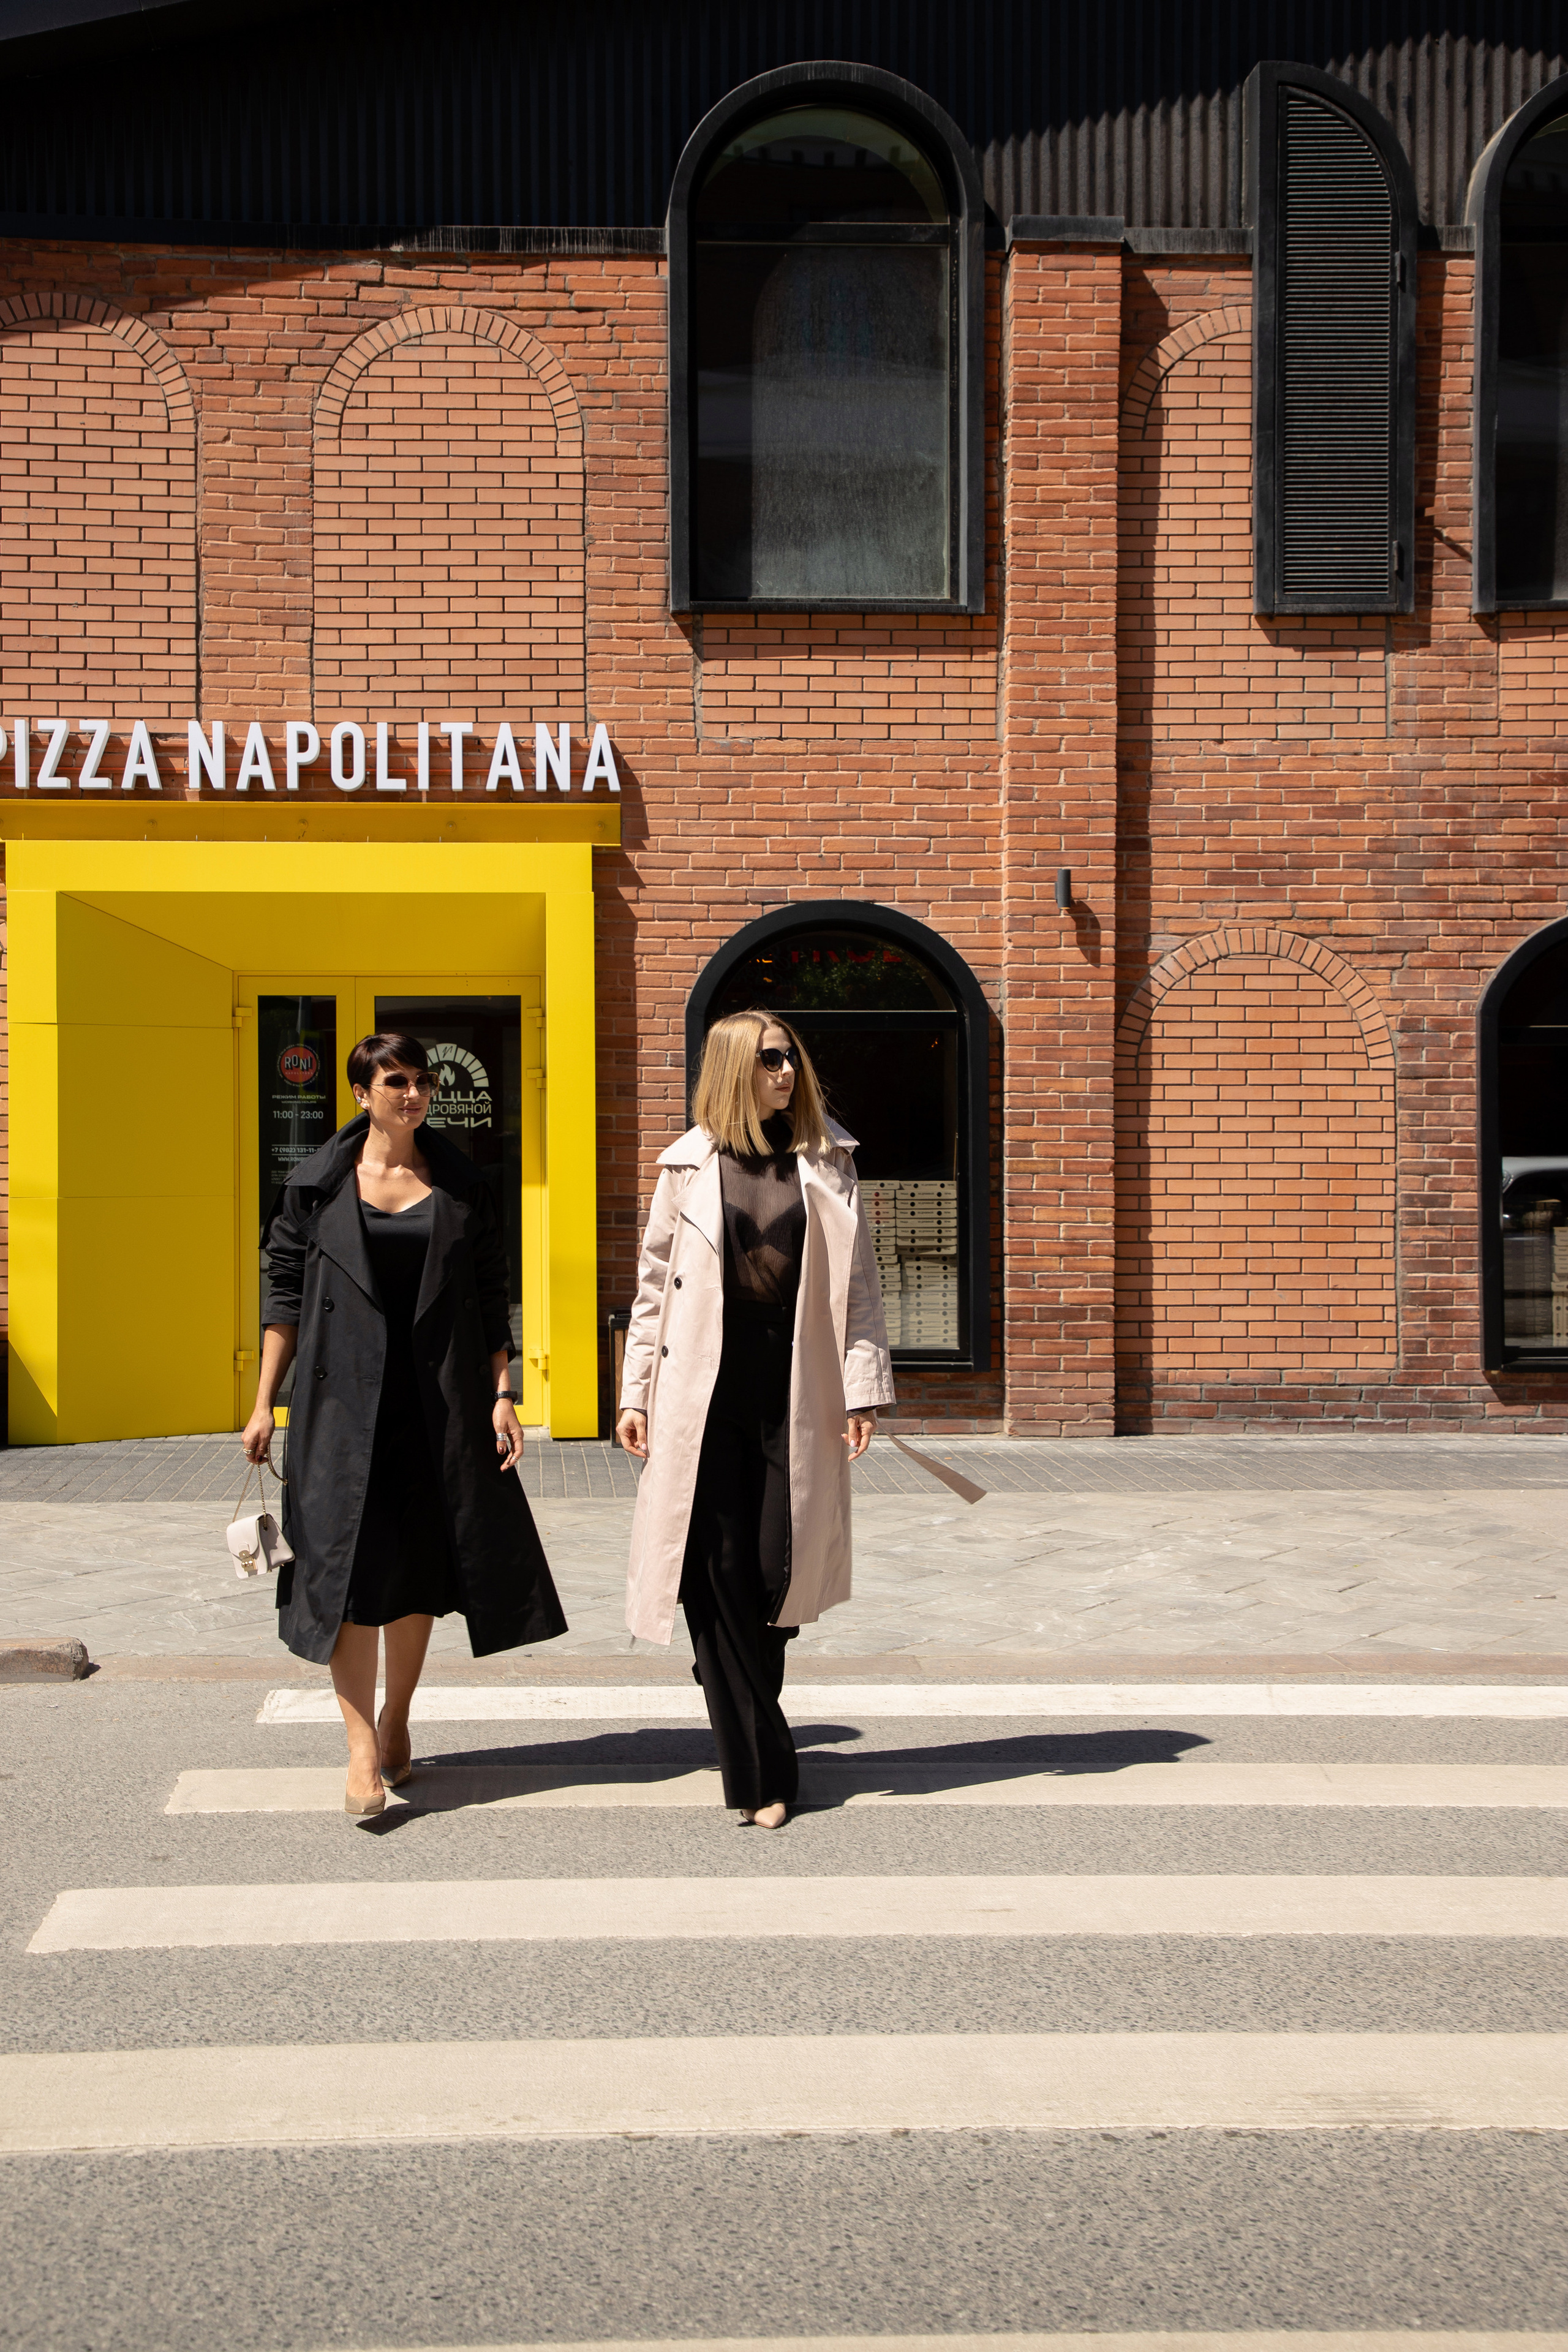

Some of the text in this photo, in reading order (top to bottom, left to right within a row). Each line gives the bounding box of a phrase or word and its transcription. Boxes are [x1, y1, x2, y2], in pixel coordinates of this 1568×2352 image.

[0, 719, 621, 792] IZZA NAPOLITANA
[284, 1054, 311, 1071] RONI
[432, 1090, 492, 1104] ЦЦА
[273, 1110, 293, 1119] 11:00
[300, 1110, 324, 1120] 23:00
[426, 1117, 492, 1128] ЕЧИ
